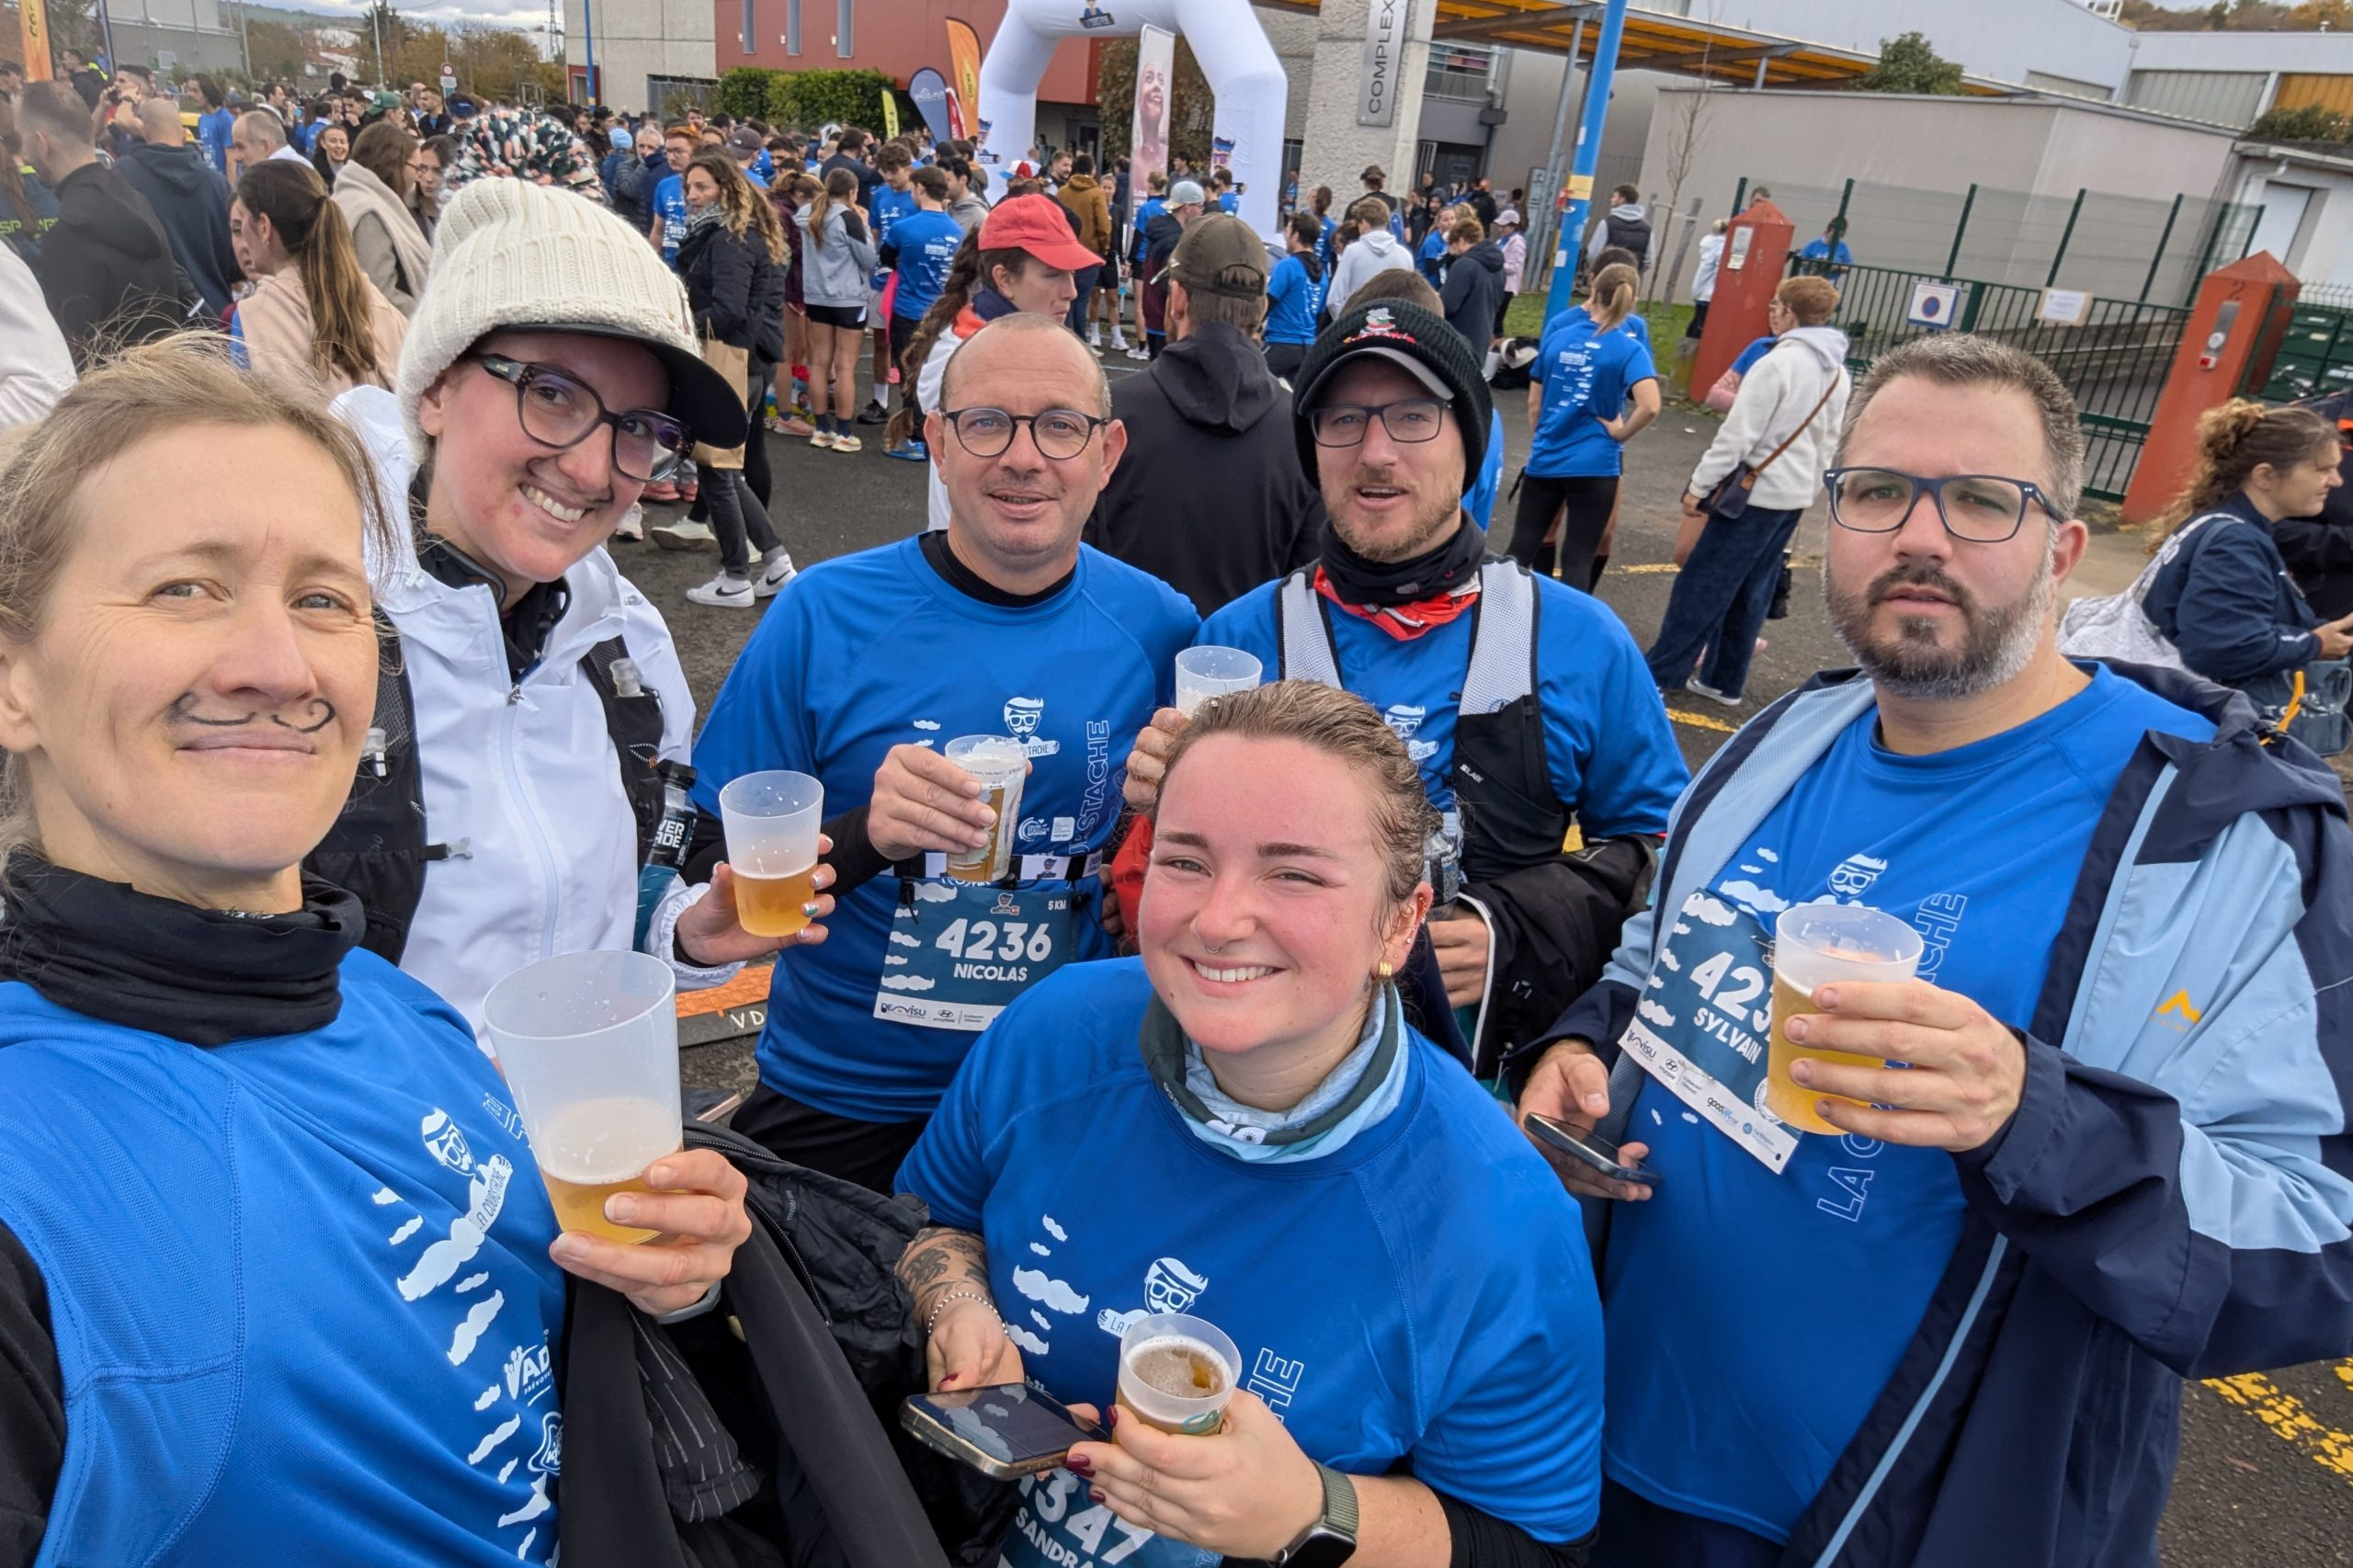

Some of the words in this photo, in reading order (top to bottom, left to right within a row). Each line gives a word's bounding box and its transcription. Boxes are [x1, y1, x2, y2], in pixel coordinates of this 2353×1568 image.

[1368, 0, 1395, 114] COMPLEX
[1048, 900, 1055, 911] 5
[1054, 900, 1067, 911] KM
[935, 917, 1052, 962] 4236
[953, 962, 1029, 983] NICOLAS
[1693, 1006, 1763, 1065] SYLVAIN
[1816, 1165, 1875, 1223] LA
[1109, 1319, 1125, 1334] LA
